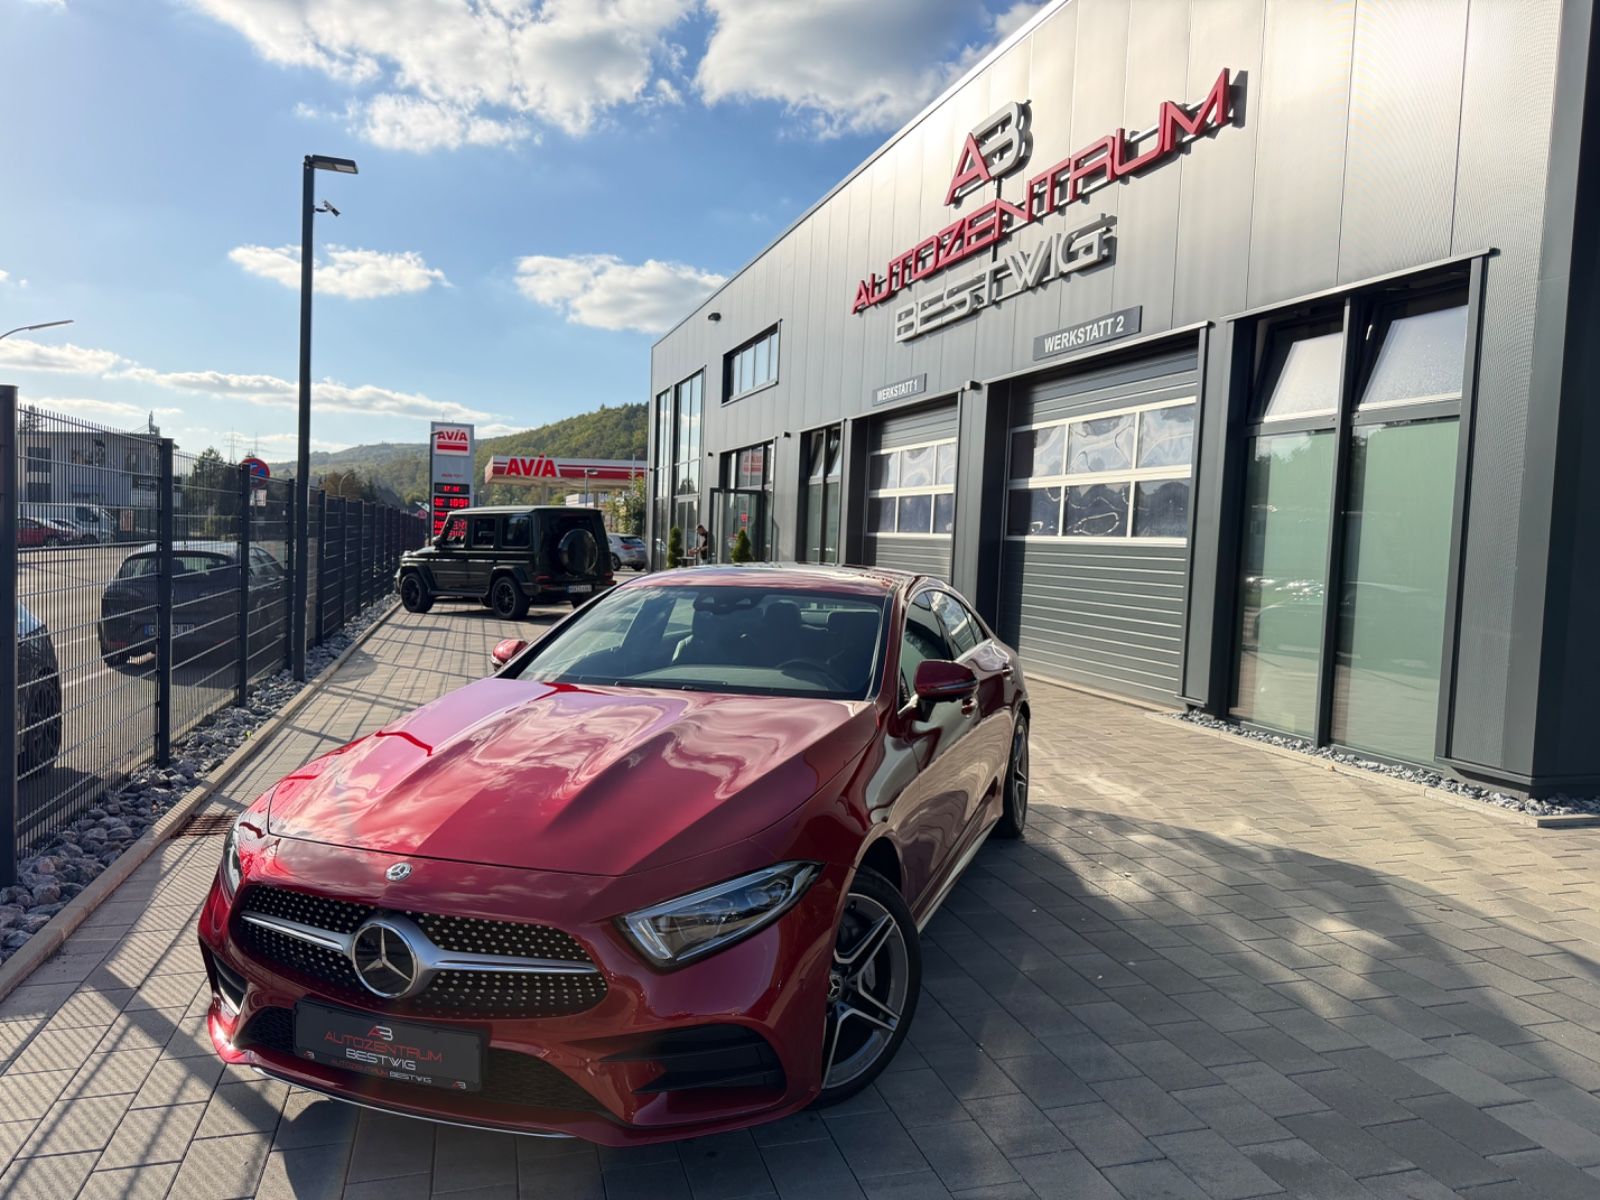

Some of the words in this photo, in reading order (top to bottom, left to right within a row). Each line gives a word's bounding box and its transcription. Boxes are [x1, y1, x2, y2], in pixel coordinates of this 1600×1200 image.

[851, 67, 1231, 315] AUTOZENTRUM
[895, 213, 1110, 343] BESTWIG
[1044, 318, 1114, 353] WERKSTATT
[1115, 315, 1125, 333] 2
[876, 379, 914, 402] WERKSTATT
[437, 429, 468, 441] AVIA
[505, 452, 558, 478] AVIA
[324, 1031, 443, 1063] AUTOZENTRUM
[345, 1048, 417, 1071] BESTWIG
[389, 1070, 433, 1085] BESTWIG
